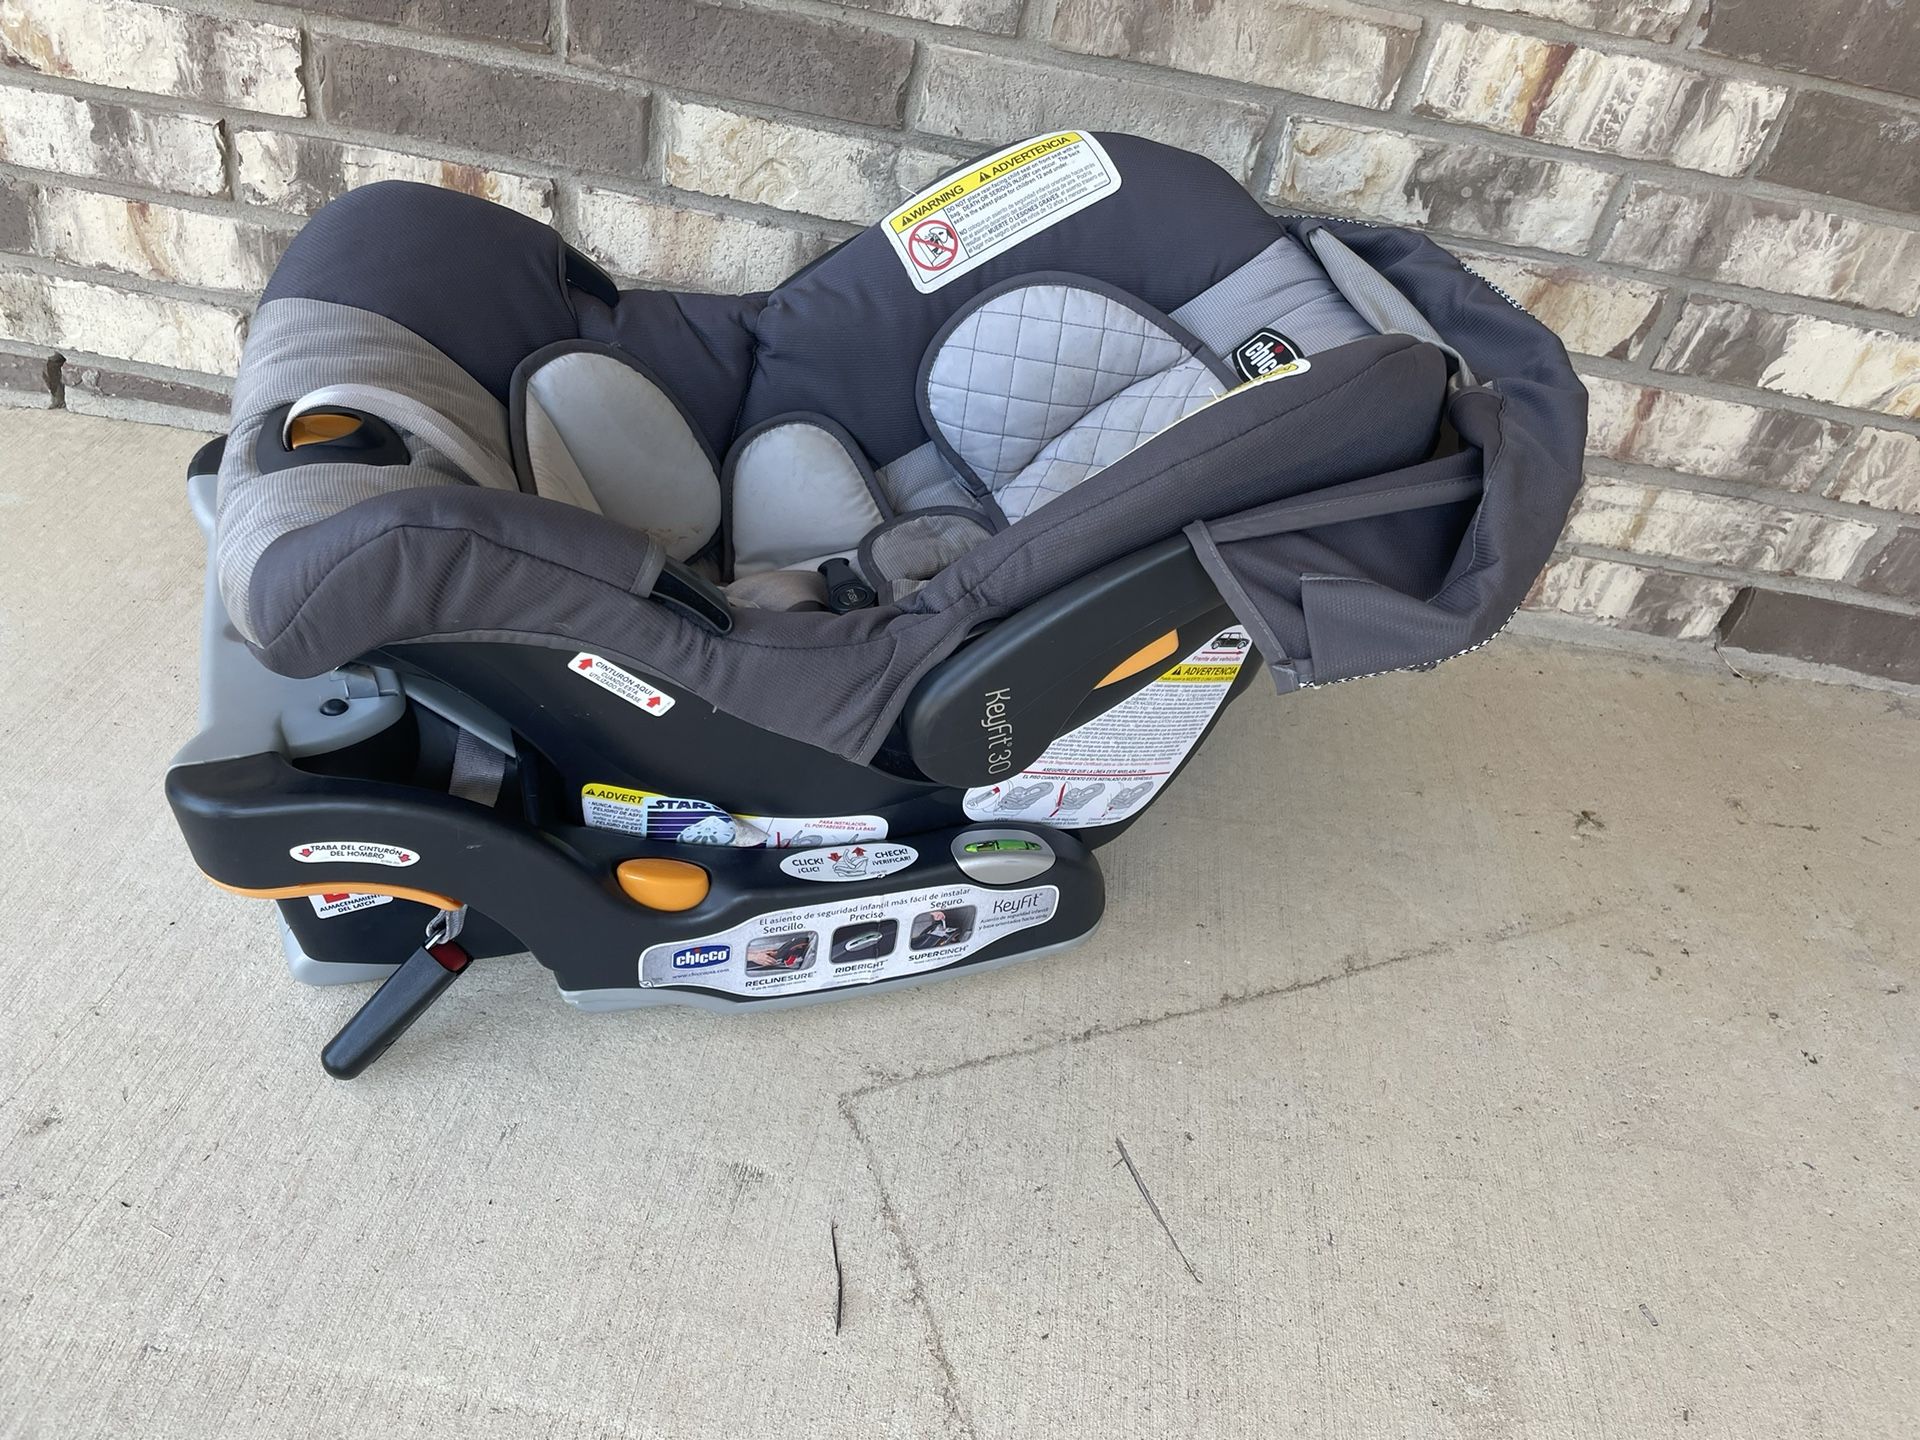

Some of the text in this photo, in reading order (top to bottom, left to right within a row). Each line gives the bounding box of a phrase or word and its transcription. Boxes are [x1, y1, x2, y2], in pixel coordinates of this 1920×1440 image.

[992, 137, 1071, 175] ADVERTENCIA
[961, 198, 980, 211] DEATH
[988, 181, 1012, 197] SERIOUS
[1011, 172, 1031, 184] INJURY
[969, 207, 978, 215] the
[978, 199, 994, 210] safest
[993, 192, 1008, 203] place
[1042, 168, 1052, 176] and
[910, 185, 964, 219] WARNING
[946, 205, 955, 213] DO
[955, 199, 966, 207] NOT
[966, 192, 981, 202] place
[987, 220, 1008, 234] MUERTE
[1012, 203, 1039, 220] LESIONES
[1245, 341, 1284, 375] chic
[1184, 667, 1238, 676] ADVERTENCIA
[589, 672, 617, 689] UTILIZADO
[626, 693, 642, 703] BASE
[601, 672, 624, 688] CUANDO
[988, 749, 1011, 774] 30
[597, 790, 643, 804] ADVERT
[650, 800, 712, 809] STAR
[593, 806, 619, 814] PELIGRO
[595, 820, 620, 828] PELIGRO
[347, 851, 384, 859] HOMBRO
[358, 845, 403, 856] CINTURÓN
[875, 848, 908, 859] CHECK!
[792, 858, 824, 867] CLICK!
[320, 894, 385, 912] ALMACENAMIENT
[353, 900, 376, 909] LATCH
[759, 918, 768, 926] El
[770, 915, 802, 925] asiento
[817, 906, 858, 919] seguridad
[860, 901, 889, 911] infantil
[891, 898, 908, 906] más
[910, 894, 927, 903] fácil
[941, 889, 971, 898] instalar
[930, 898, 965, 909] Seguro.
[993, 893, 1039, 914] KeyFit
[849, 911, 886, 922] Preciso.
[763, 923, 806, 934] Sencillo.
[675, 947, 727, 966] chicco
[908, 946, 966, 961] SUPERCINCH
[834, 961, 885, 973] RIDERIGHT
[745, 972, 813, 987] RECLINESURE
